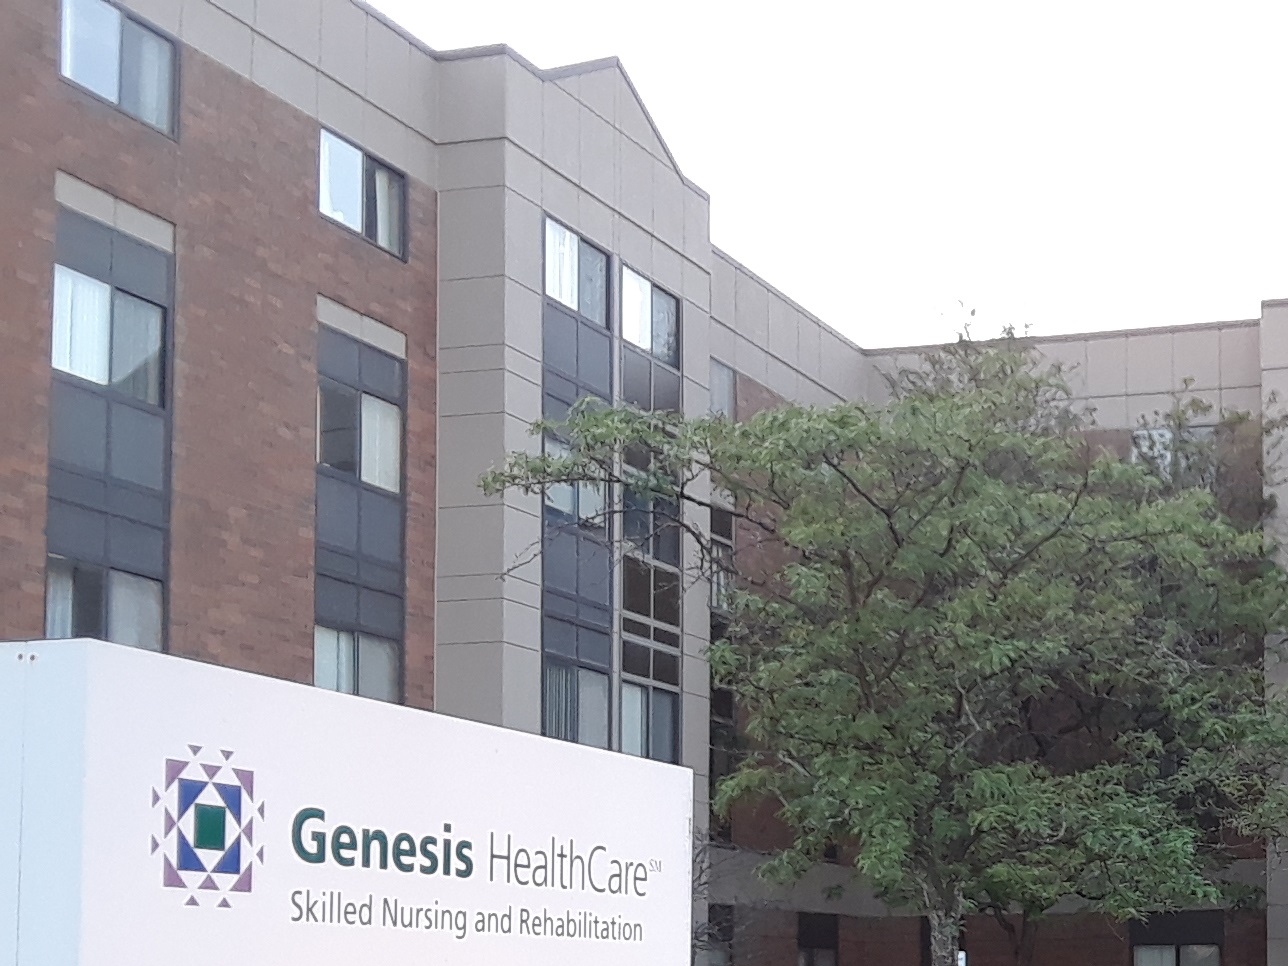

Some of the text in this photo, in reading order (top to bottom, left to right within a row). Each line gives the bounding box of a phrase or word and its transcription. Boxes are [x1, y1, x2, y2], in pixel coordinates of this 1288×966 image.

[291, 807, 474, 879] Genesis
[488, 831, 648, 897] HealthCare
[290, 890, 643, 942] Skilled Nursing and Rehabilitation
